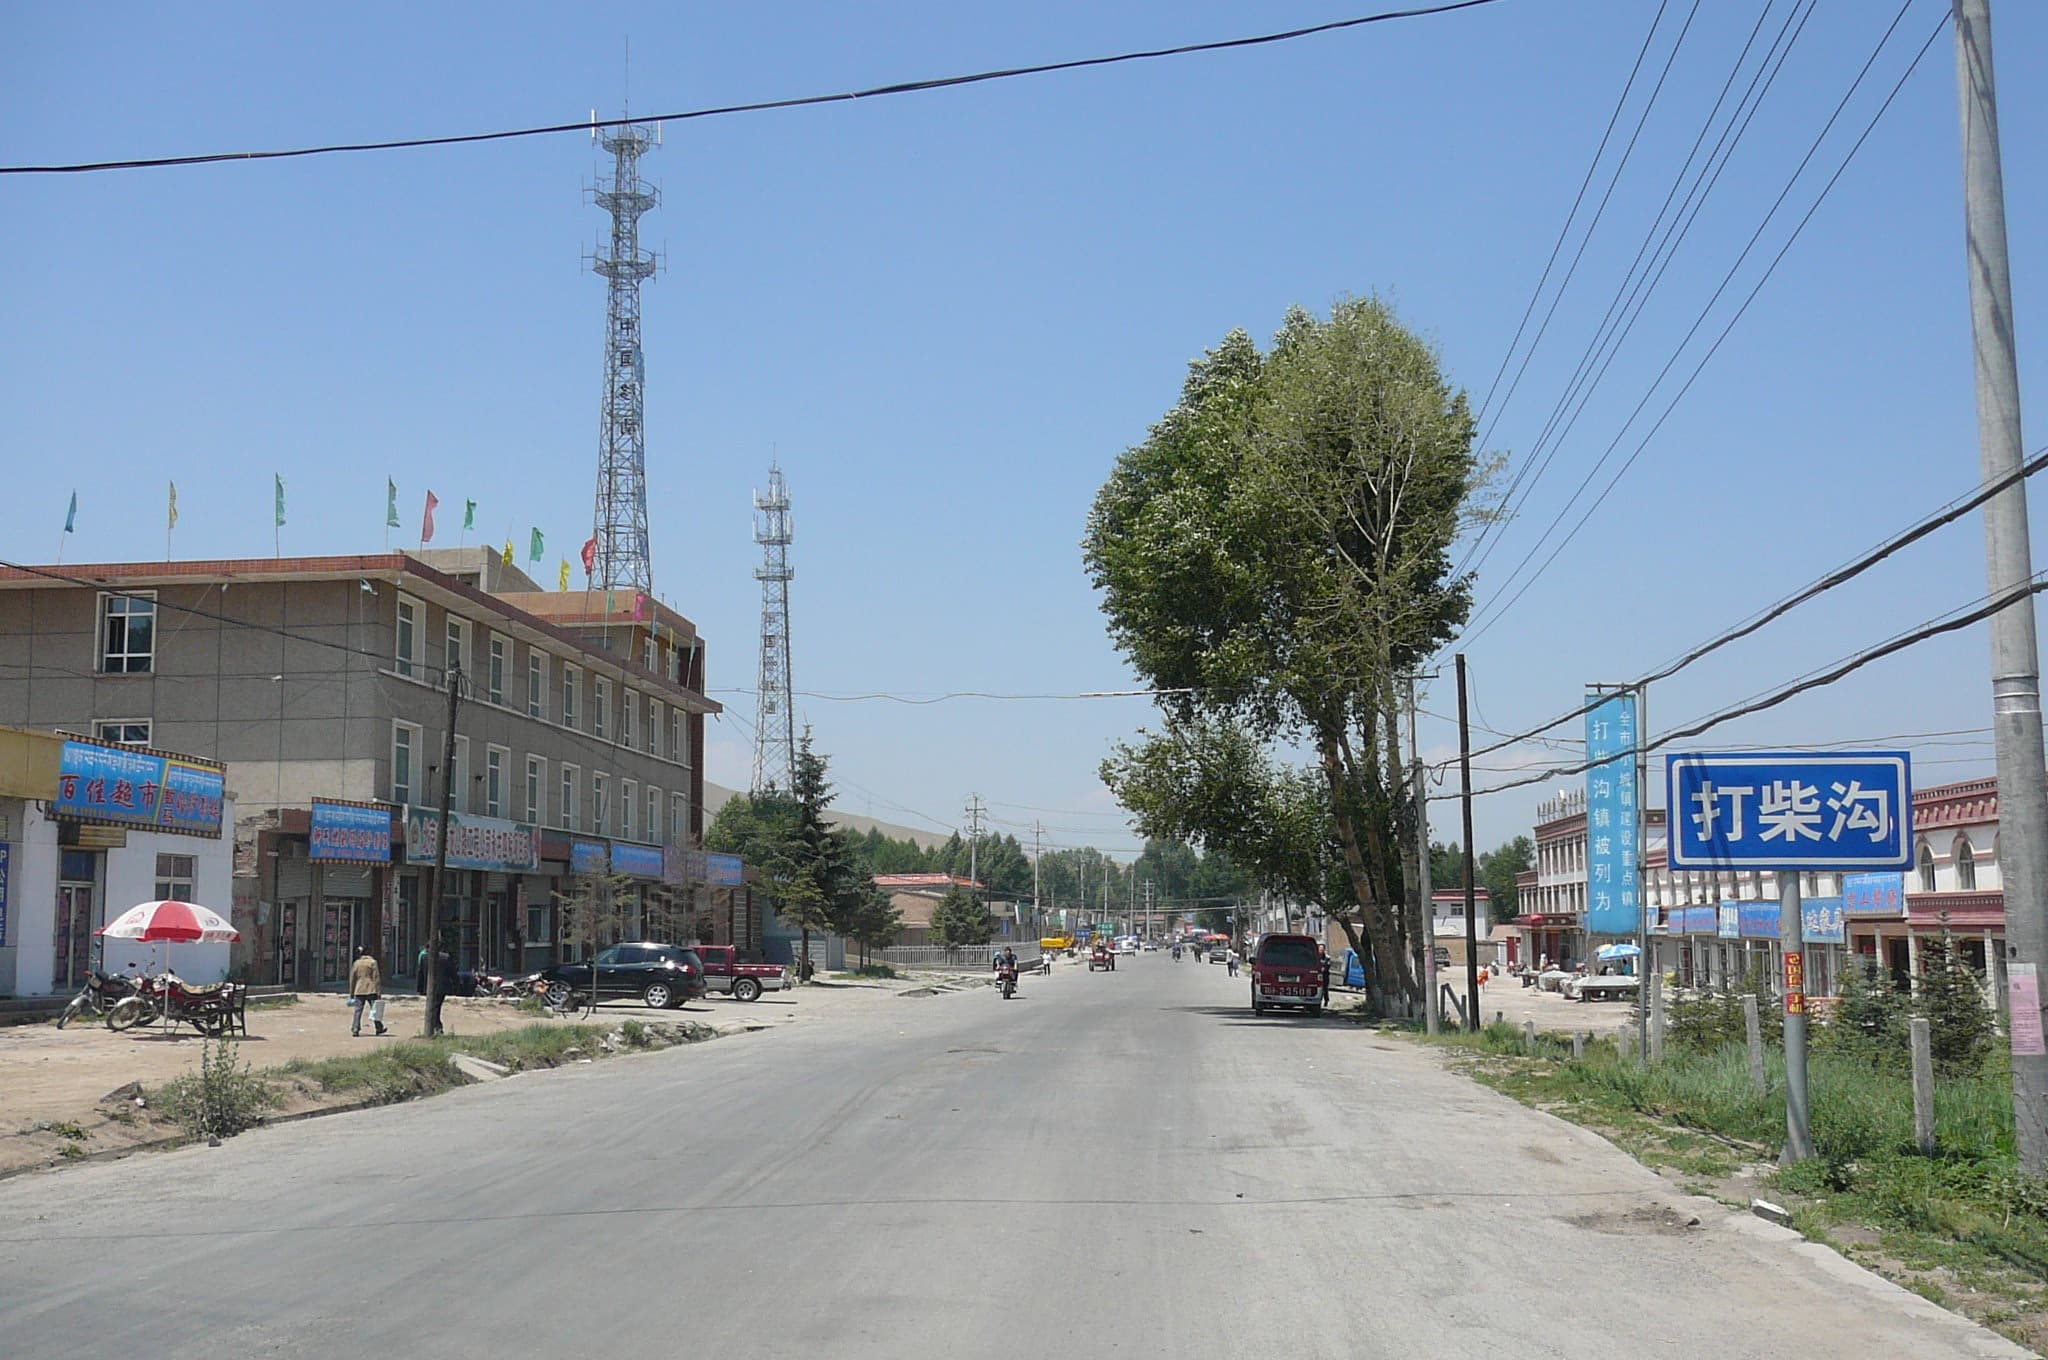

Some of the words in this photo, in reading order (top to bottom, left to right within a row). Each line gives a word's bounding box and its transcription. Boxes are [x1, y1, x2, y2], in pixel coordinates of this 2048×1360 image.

[60, 774, 160, 812] 百佳超市
[1592, 719, 1611, 911] 打柴沟镇被列为
[1691, 780, 1889, 842] 打柴沟
